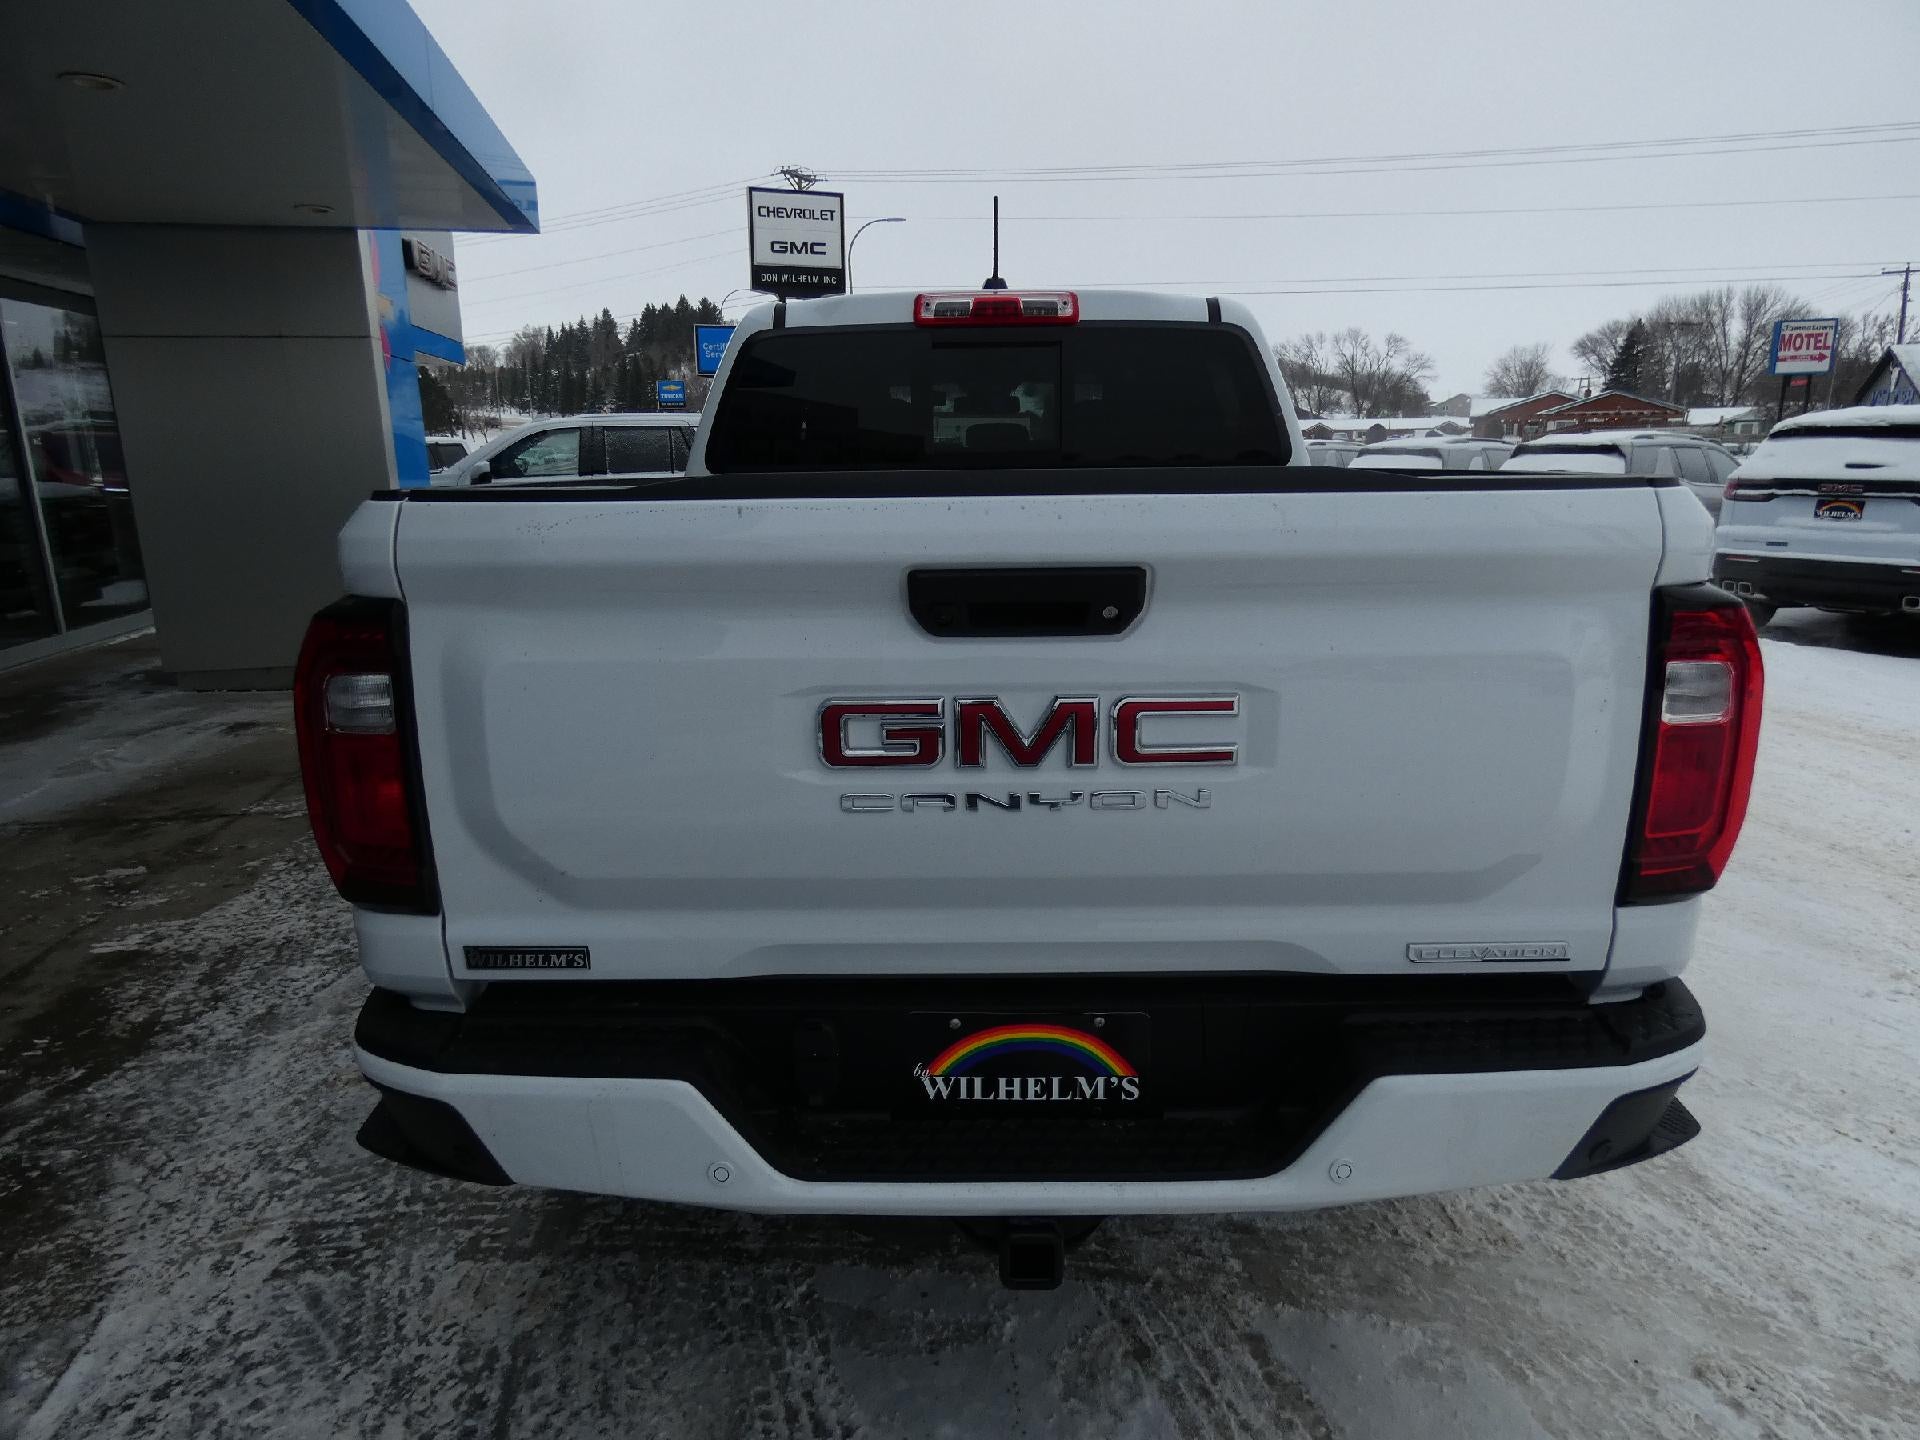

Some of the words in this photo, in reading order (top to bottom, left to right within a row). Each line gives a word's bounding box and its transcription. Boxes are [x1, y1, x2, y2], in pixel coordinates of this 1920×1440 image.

[757, 205, 836, 221] CHEVROLET
[770, 240, 827, 256] GMC
[761, 273, 778, 283] DON
[1778, 332, 1831, 352] MOTEL
[817, 694, 1240, 769] GMC
[840, 789, 1212, 813] CANYON
[920, 1075, 1141, 1101] WILHELM'S
